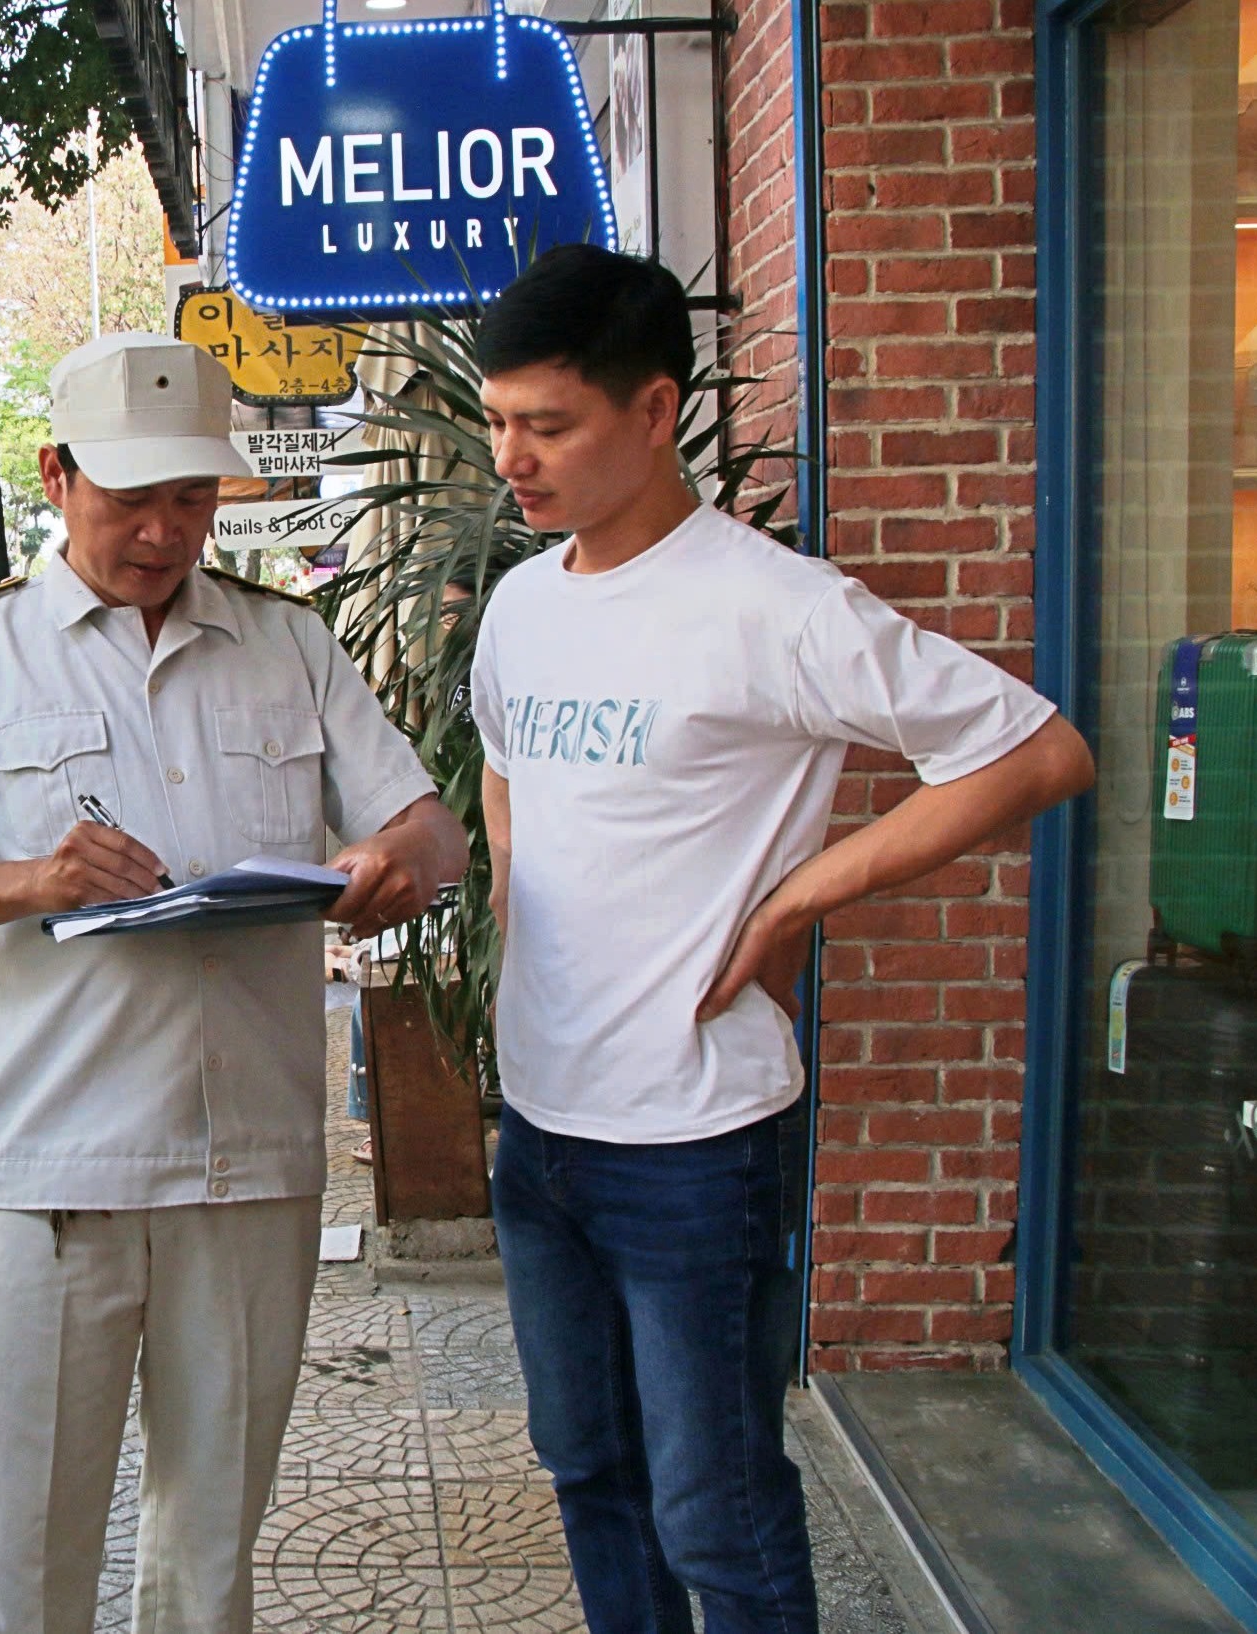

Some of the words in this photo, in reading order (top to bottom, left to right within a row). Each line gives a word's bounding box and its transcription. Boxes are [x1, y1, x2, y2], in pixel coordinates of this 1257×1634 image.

[280, 127, 558, 206] MELIOR
[322, 217, 519, 254] LUXURY
[208, 331, 345, 370] 마사지
[279, 377, 347, 395] 2층-4층
[247, 432, 336, 453] 발각질제거
[219, 518, 263, 536] Nails
[268, 516, 281, 532] &
[286, 513, 326, 531] Foot
[330, 512, 355, 528] Ca
[506, 695, 661, 767] HERISH
